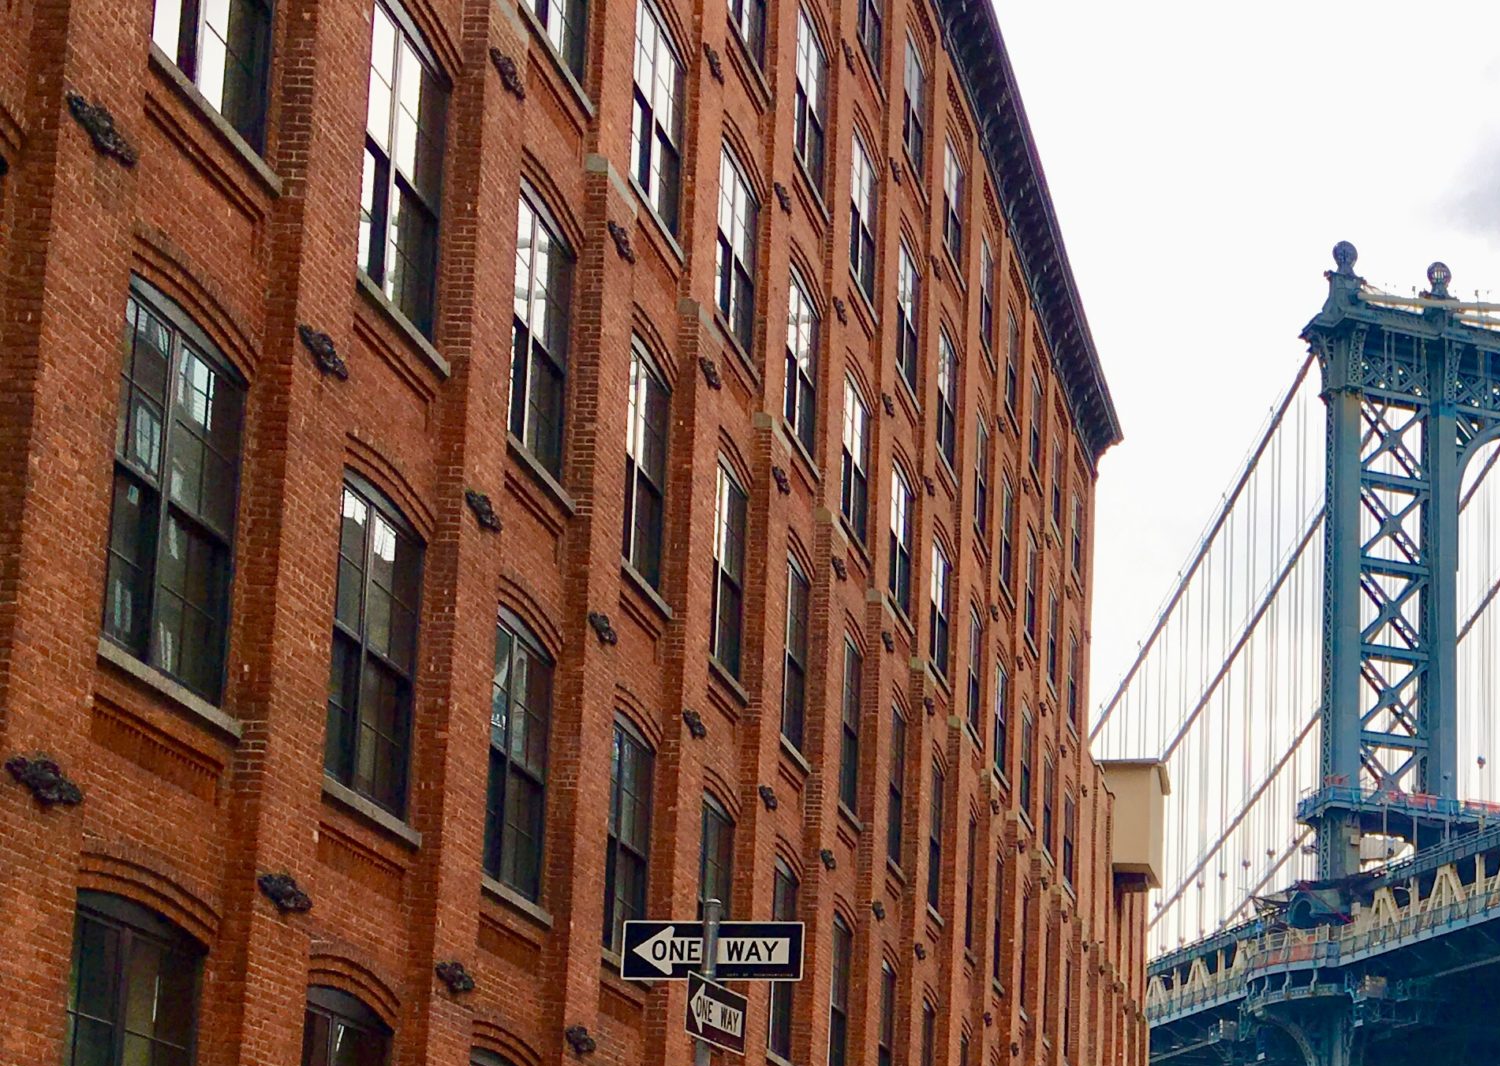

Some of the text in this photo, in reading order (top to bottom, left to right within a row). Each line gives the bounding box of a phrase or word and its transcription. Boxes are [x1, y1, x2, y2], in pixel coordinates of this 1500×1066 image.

[651, 939, 779, 962] ONE WAY
[695, 995, 740, 1034] ONE WAY
